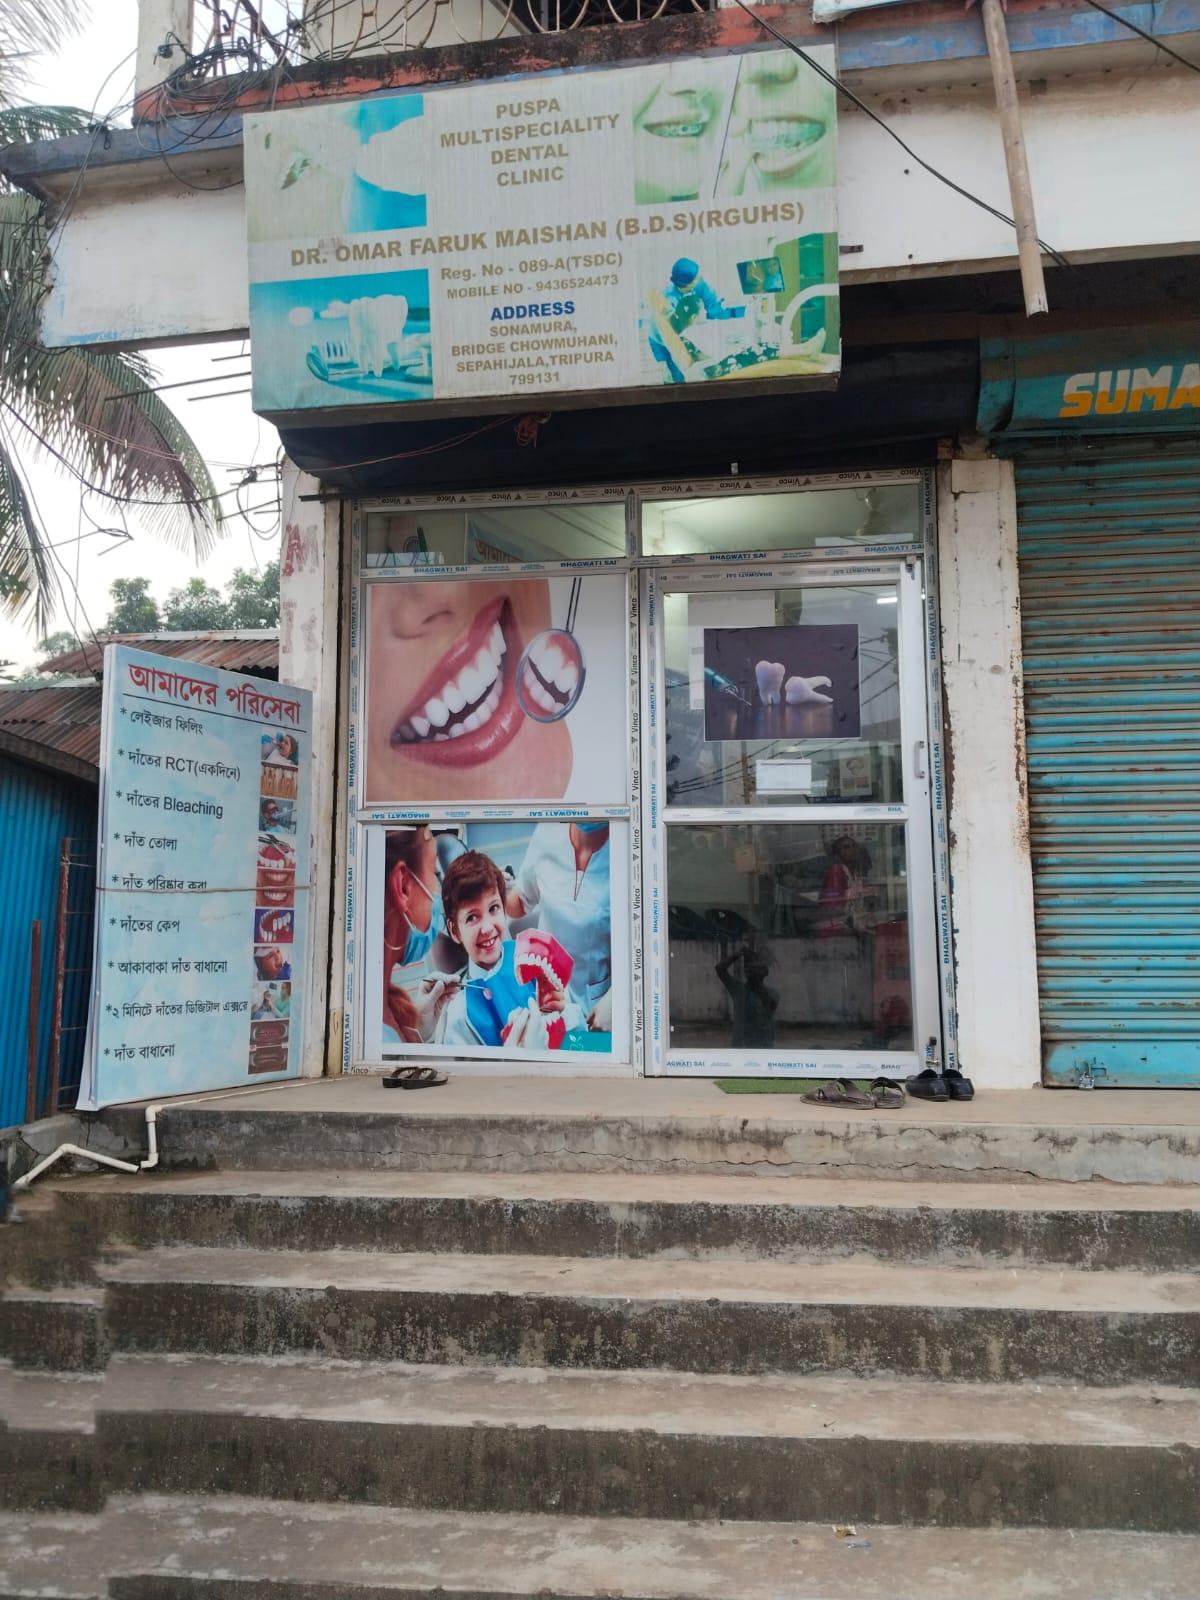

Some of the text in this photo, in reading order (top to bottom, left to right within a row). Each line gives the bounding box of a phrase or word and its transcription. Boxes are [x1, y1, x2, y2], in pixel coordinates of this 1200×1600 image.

[496, 98, 561, 119] PUSPA
[440, 113, 620, 148] MULTISPECIALITY
[491, 143, 569, 165] DENTAL
[497, 166, 564, 187] CLINIC
[291, 202, 804, 266] DR. OMAR FARUK MAISHAN (B.D.S)(RGUHS)
[441, 267, 476, 281] Reg.
[482, 263, 504, 277] No
[519, 252, 623, 273] 089-A(TSDC)
[447, 284, 499, 299] MOBILE
[503, 283, 524, 294] NO
[535, 274, 619, 292] 9436524473
[490, 301, 575, 321] ADDRESS
[490, 321, 577, 337] SONAMURA,
[451, 334, 618, 357] BRIDGE CHOWMUHANI,
[456, 351, 614, 373] SEPAHIJALA,TRIPURA
[509, 372, 560, 386] 799131
[128, 663, 219, 707] আমাদের
[226, 682, 302, 725] পরিসেবা
[130, 708, 204, 736] লেইজার ফিলিং
[128, 748, 162, 768] দাঁতের
[126, 789, 224, 820] দাঁতের Bleaching
[124, 831, 178, 851] দাঁত তোলা
[122, 873, 144, 891] দাঁত
[120, 915, 181, 933] দাঁতের কেপ
[118, 957, 228, 974] আকাবাকা দাঁত বাধানো
[122, 1002, 153, 1018] মিনিটে
[155, 1001, 183, 1016] দাঁতের
[185, 1000, 220, 1014] ডিজিটাল
[222, 1001, 249, 1012] এক্সরে
[114, 1043, 176, 1061] দাঁত বাধানো
